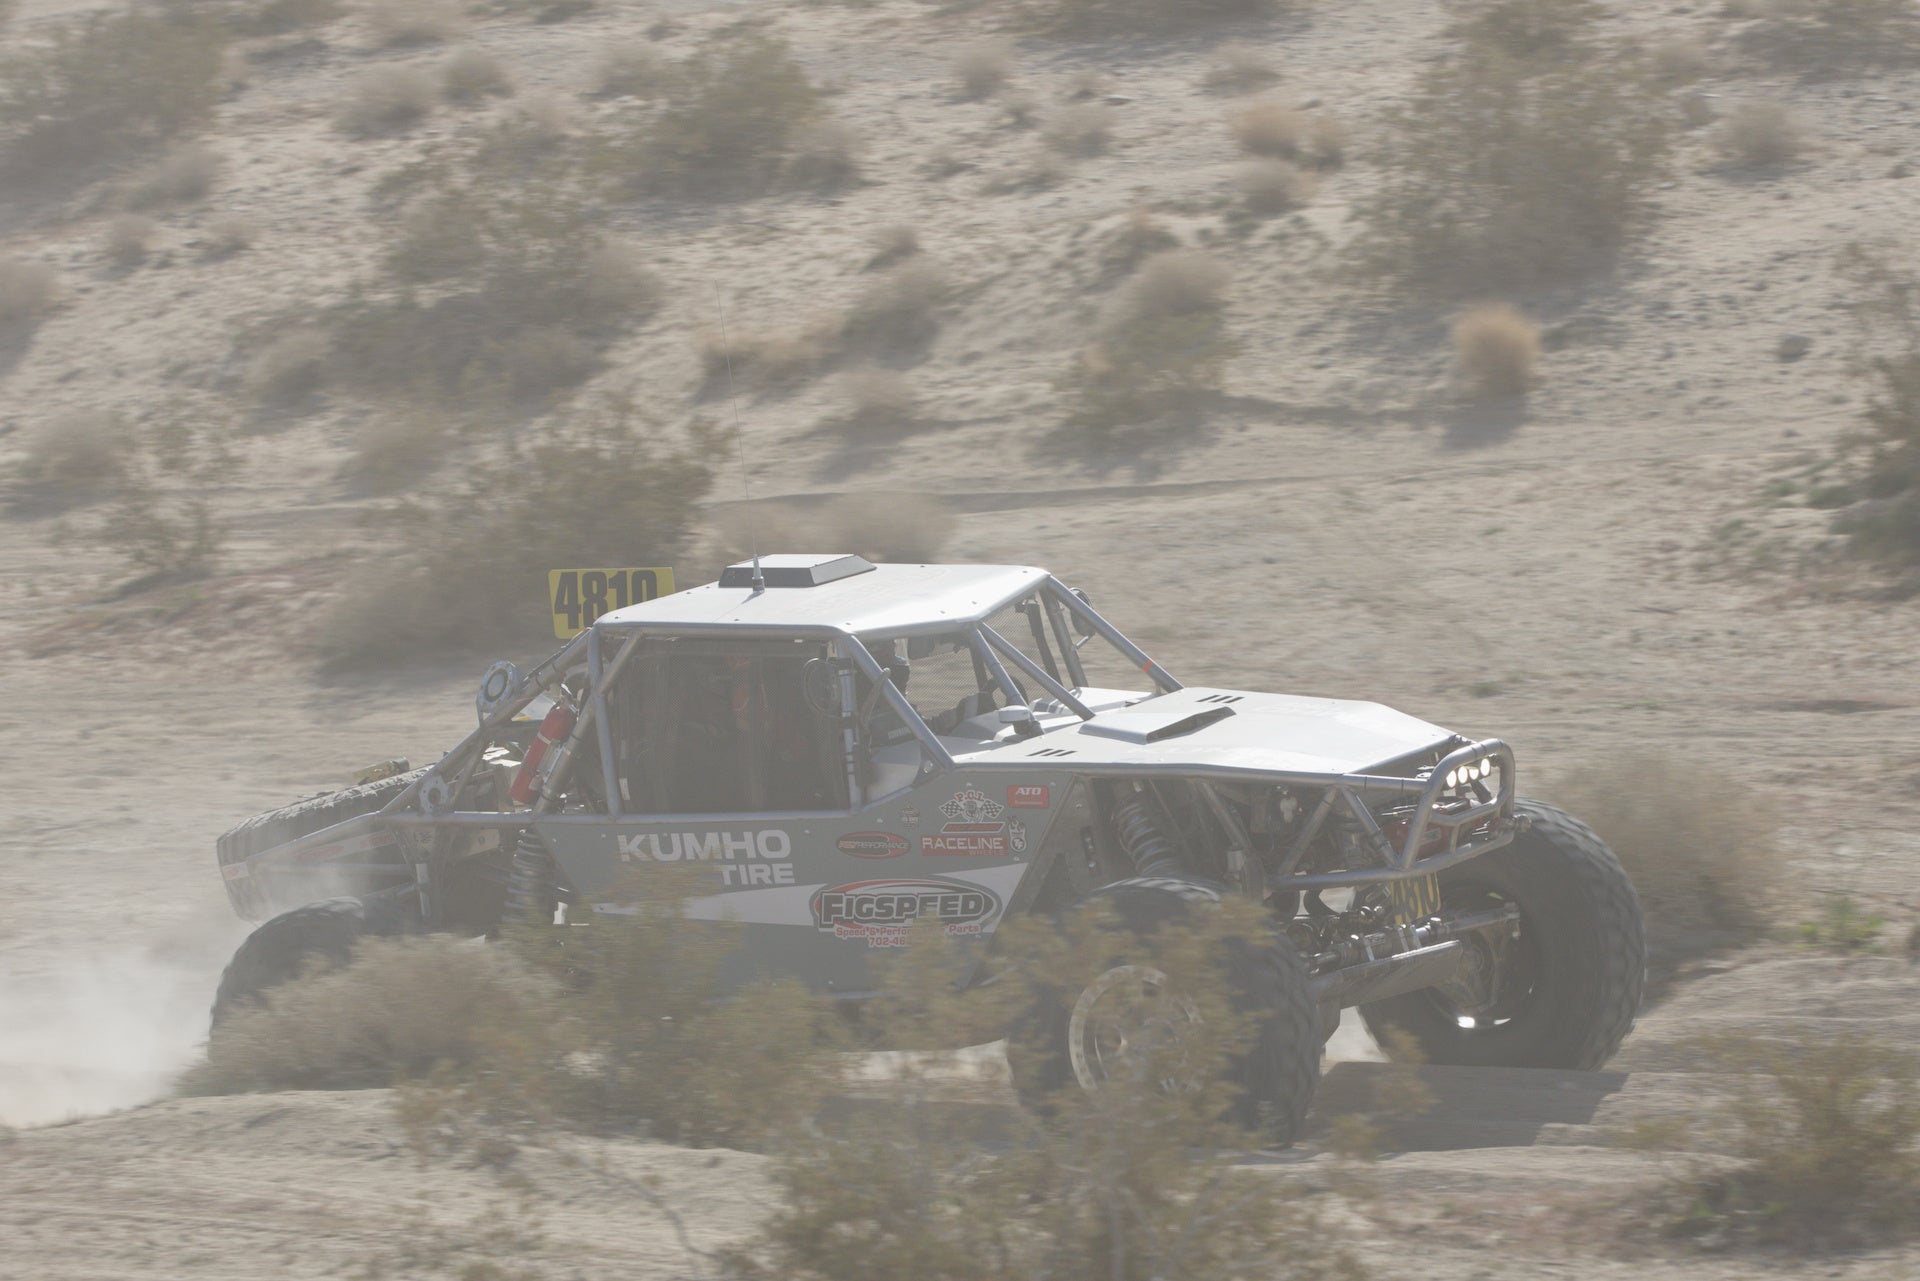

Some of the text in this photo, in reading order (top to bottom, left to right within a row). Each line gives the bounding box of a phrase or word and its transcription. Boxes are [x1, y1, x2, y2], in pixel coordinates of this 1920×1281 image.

[554, 570, 658, 629] 4810
[617, 829, 792, 862] KUMHO
[922, 837, 1003, 850] RACELINE
[720, 863, 795, 886] TIRE
[949, 924, 980, 933] Parts
